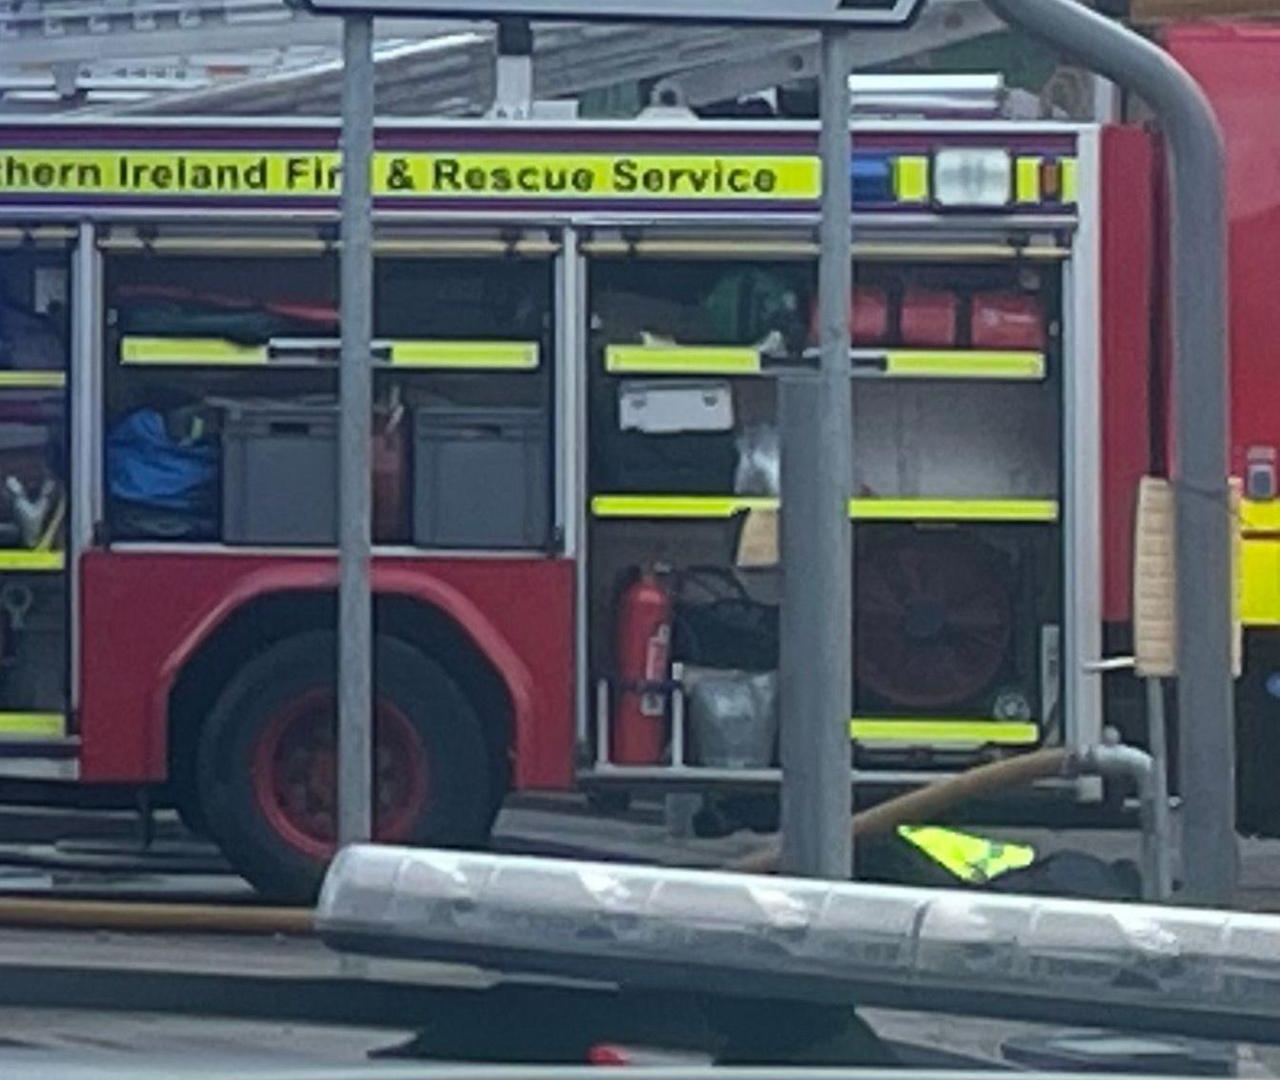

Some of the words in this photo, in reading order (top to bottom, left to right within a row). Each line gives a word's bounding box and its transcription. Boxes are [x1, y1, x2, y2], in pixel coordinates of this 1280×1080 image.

[118, 156, 268, 190] Ireland
[286, 158, 342, 190] Fir
[385, 160, 414, 191] &
[435, 160, 594, 193] Rescue
[613, 159, 778, 193] Service
